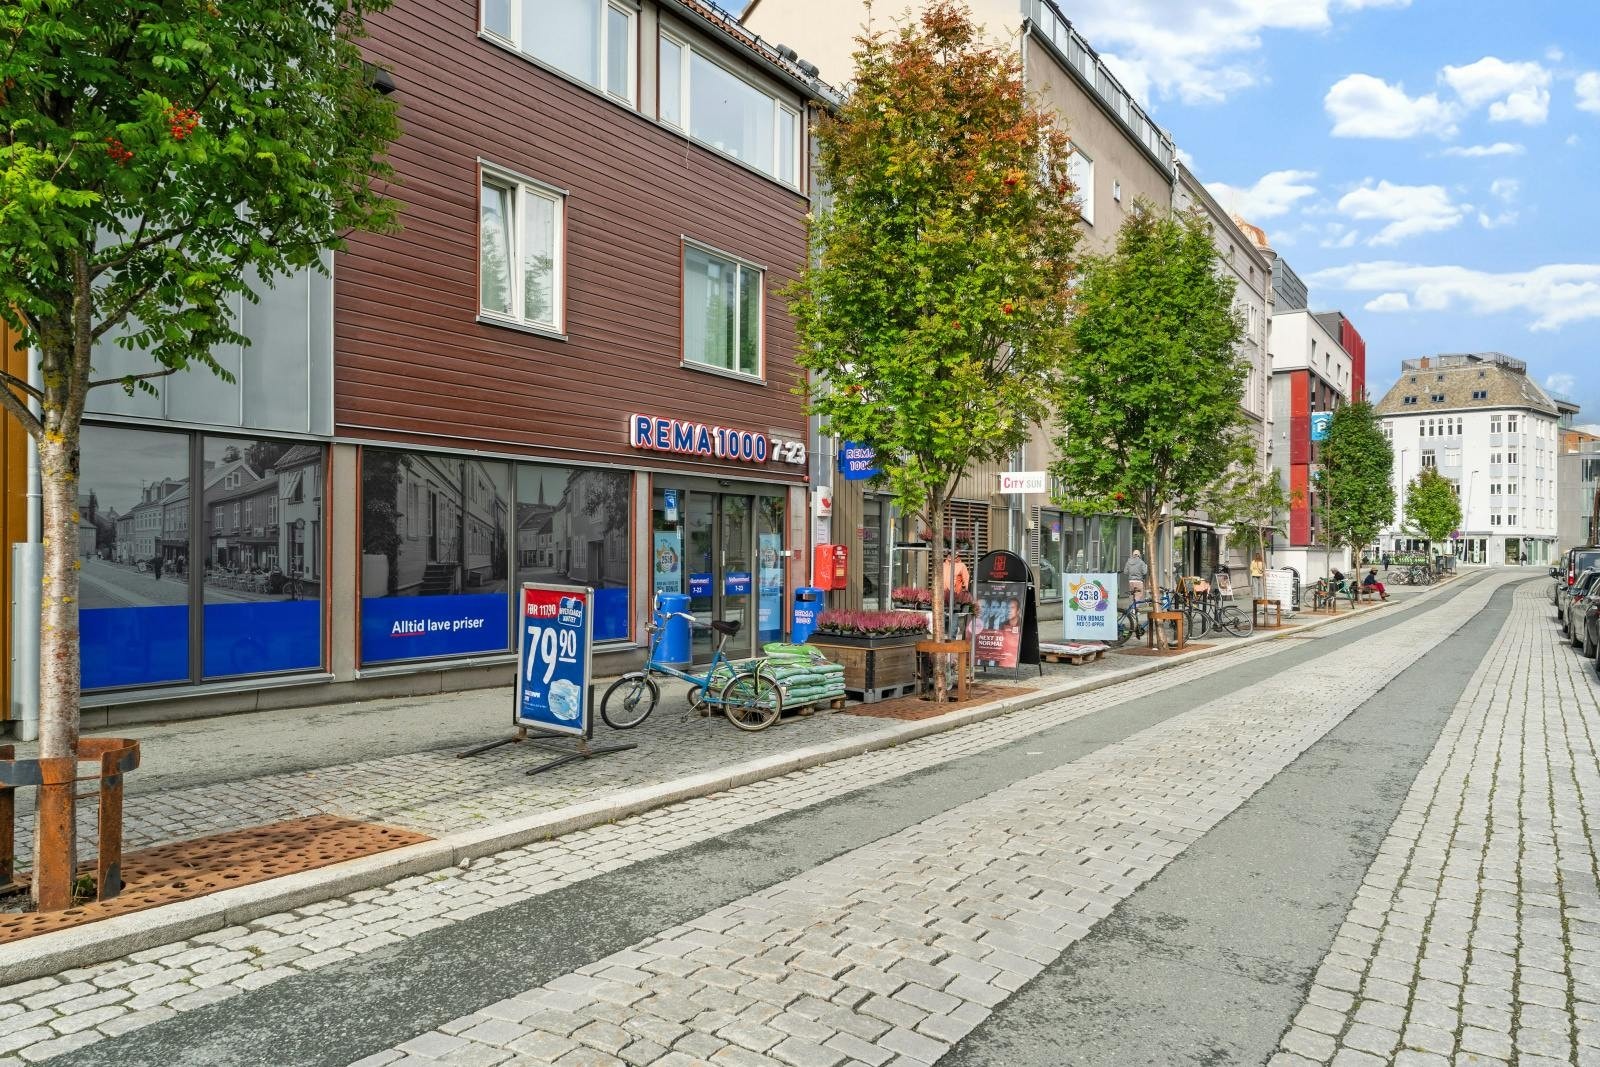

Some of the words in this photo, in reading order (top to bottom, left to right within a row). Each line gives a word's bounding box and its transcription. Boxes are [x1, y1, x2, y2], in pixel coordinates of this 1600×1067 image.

[631, 414, 712, 456] REMA
[713, 427, 767, 464] 1000
[770, 438, 806, 465] 7-23
[527, 603, 538, 615] FØR
[794, 610, 813, 618] REMA
[392, 619, 425, 634] Alltid
[427, 619, 451, 631] lave
[453, 616, 484, 632] priser
[526, 625, 558, 685] 79
